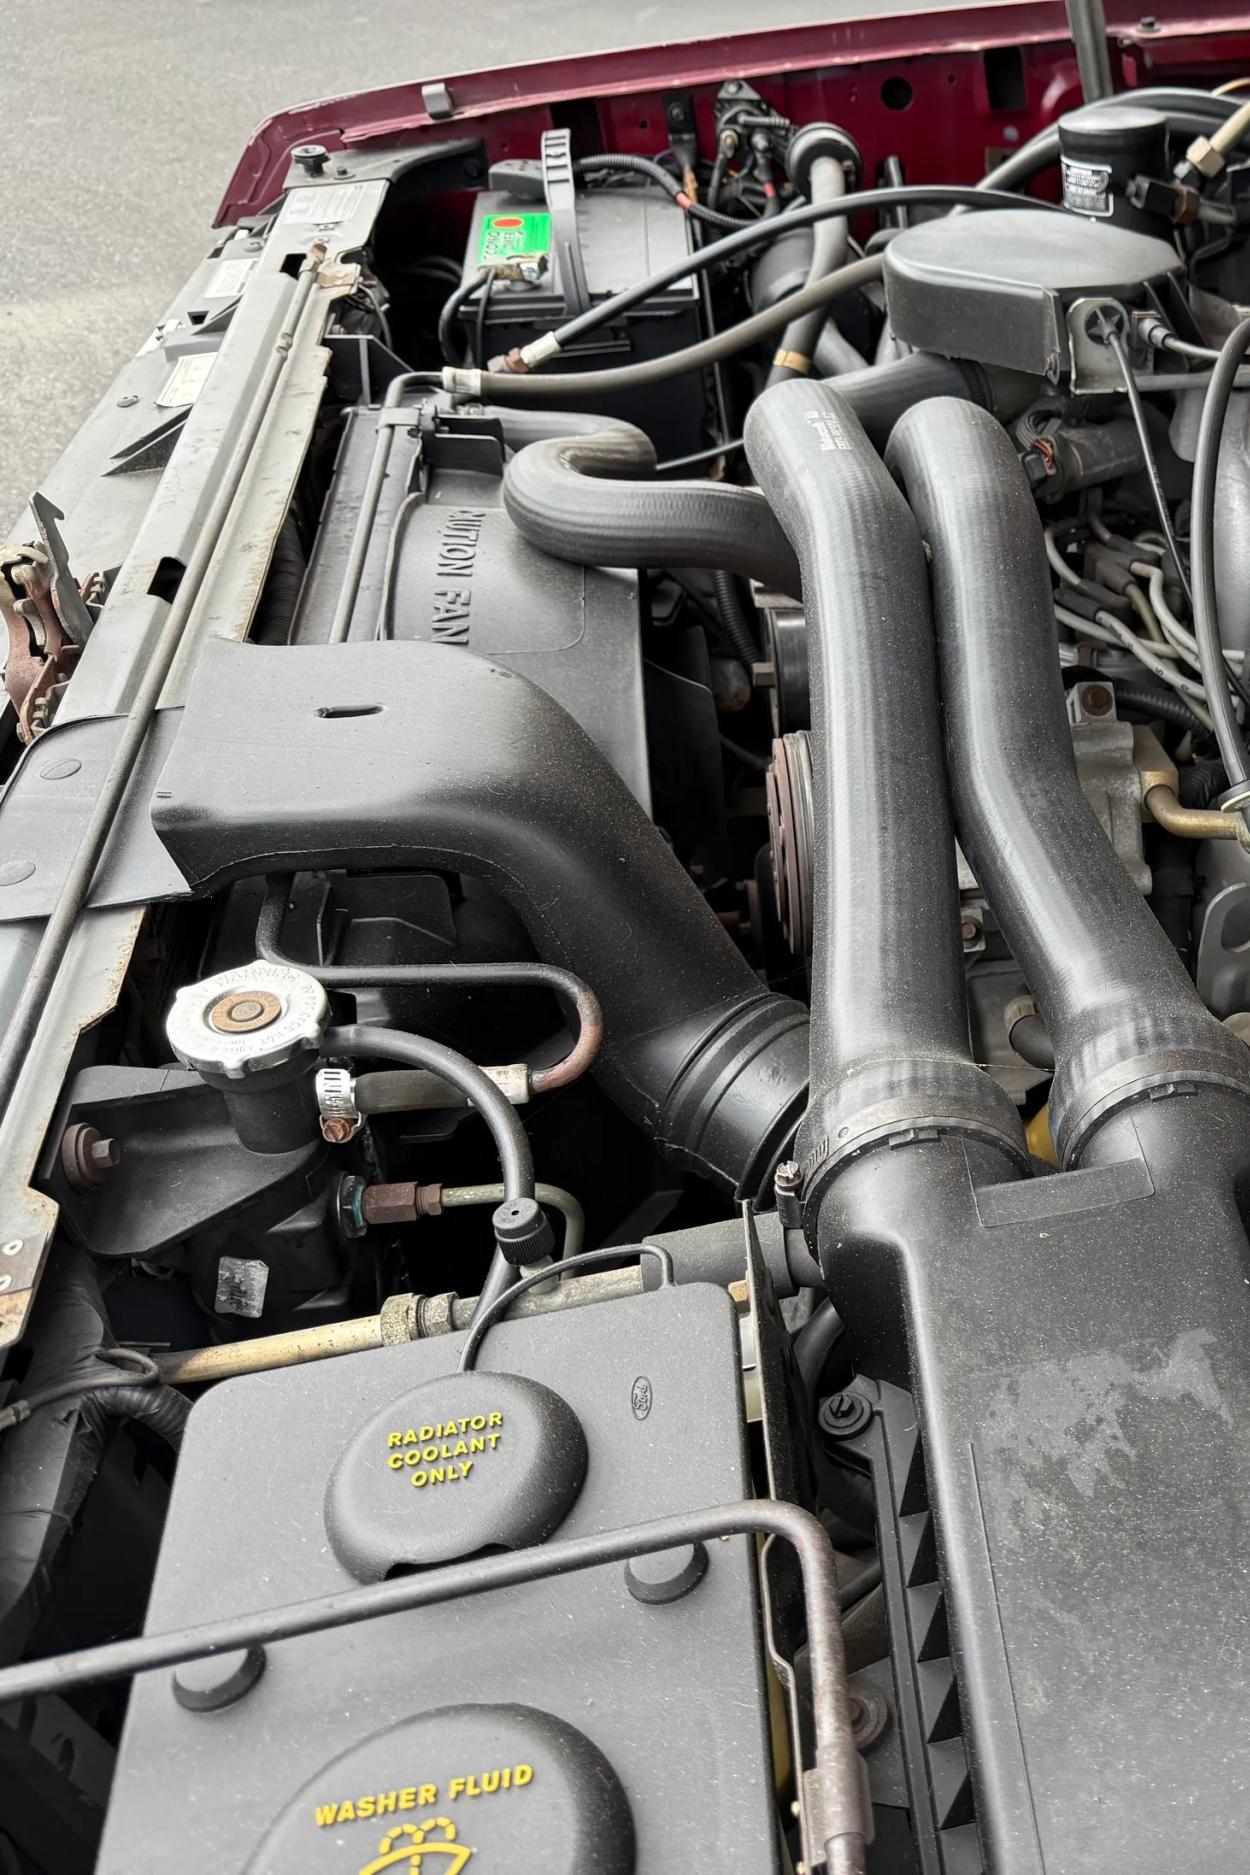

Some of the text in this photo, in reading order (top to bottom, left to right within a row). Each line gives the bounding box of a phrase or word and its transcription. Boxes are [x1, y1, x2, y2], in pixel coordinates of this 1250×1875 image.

[431, 590, 471, 646] FAN
[388, 1412, 503, 1449] RADIATOR
[388, 1433, 500, 1470] COOLANT
[411, 1461, 474, 1488] ONLY
[314, 1764, 535, 1829] WASHER FLUID
